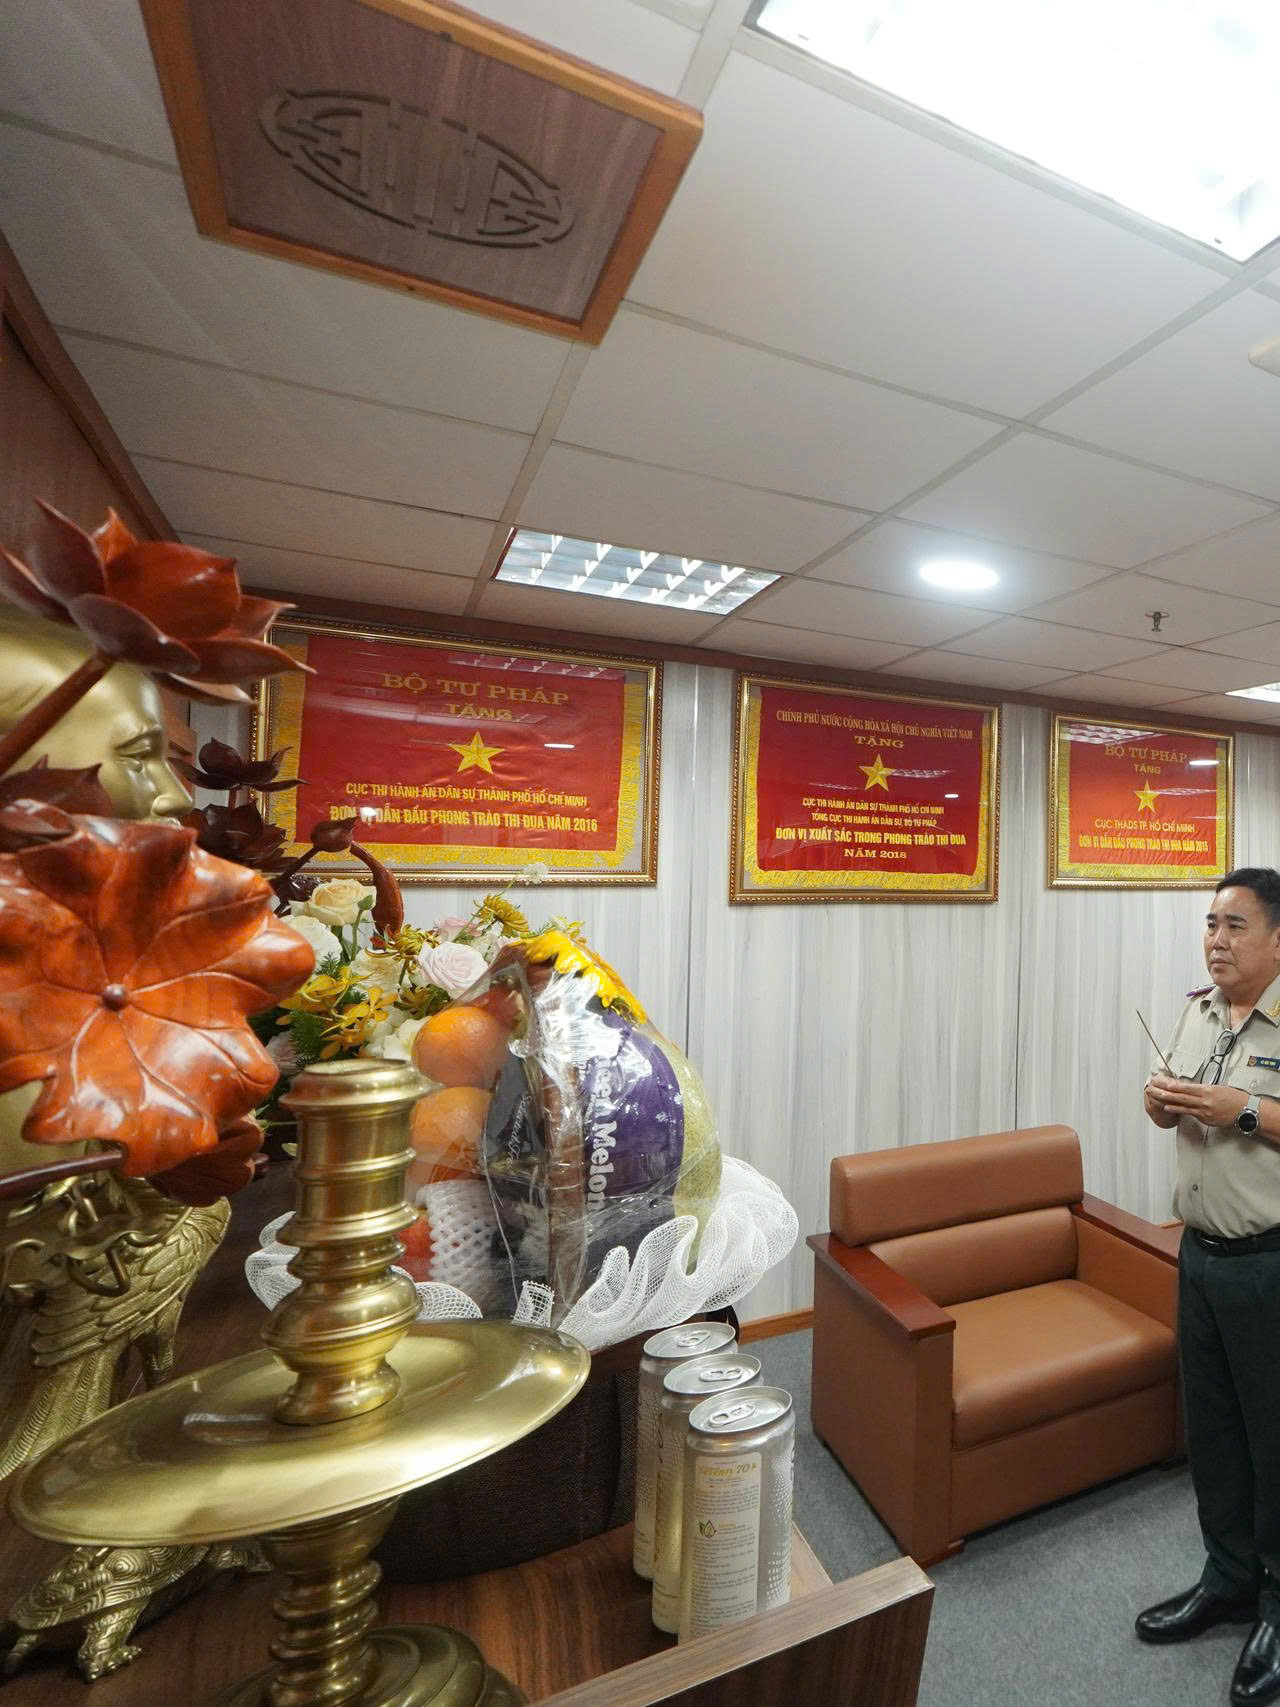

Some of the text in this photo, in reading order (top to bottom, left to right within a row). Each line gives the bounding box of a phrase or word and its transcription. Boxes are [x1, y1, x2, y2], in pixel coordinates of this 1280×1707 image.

[383, 672, 569, 705] BỘ TƯ PHÁP
[854, 735, 904, 749] TẶNG
[843, 847, 907, 859] NĂM 2018
[587, 1121, 618, 1211] Melon
